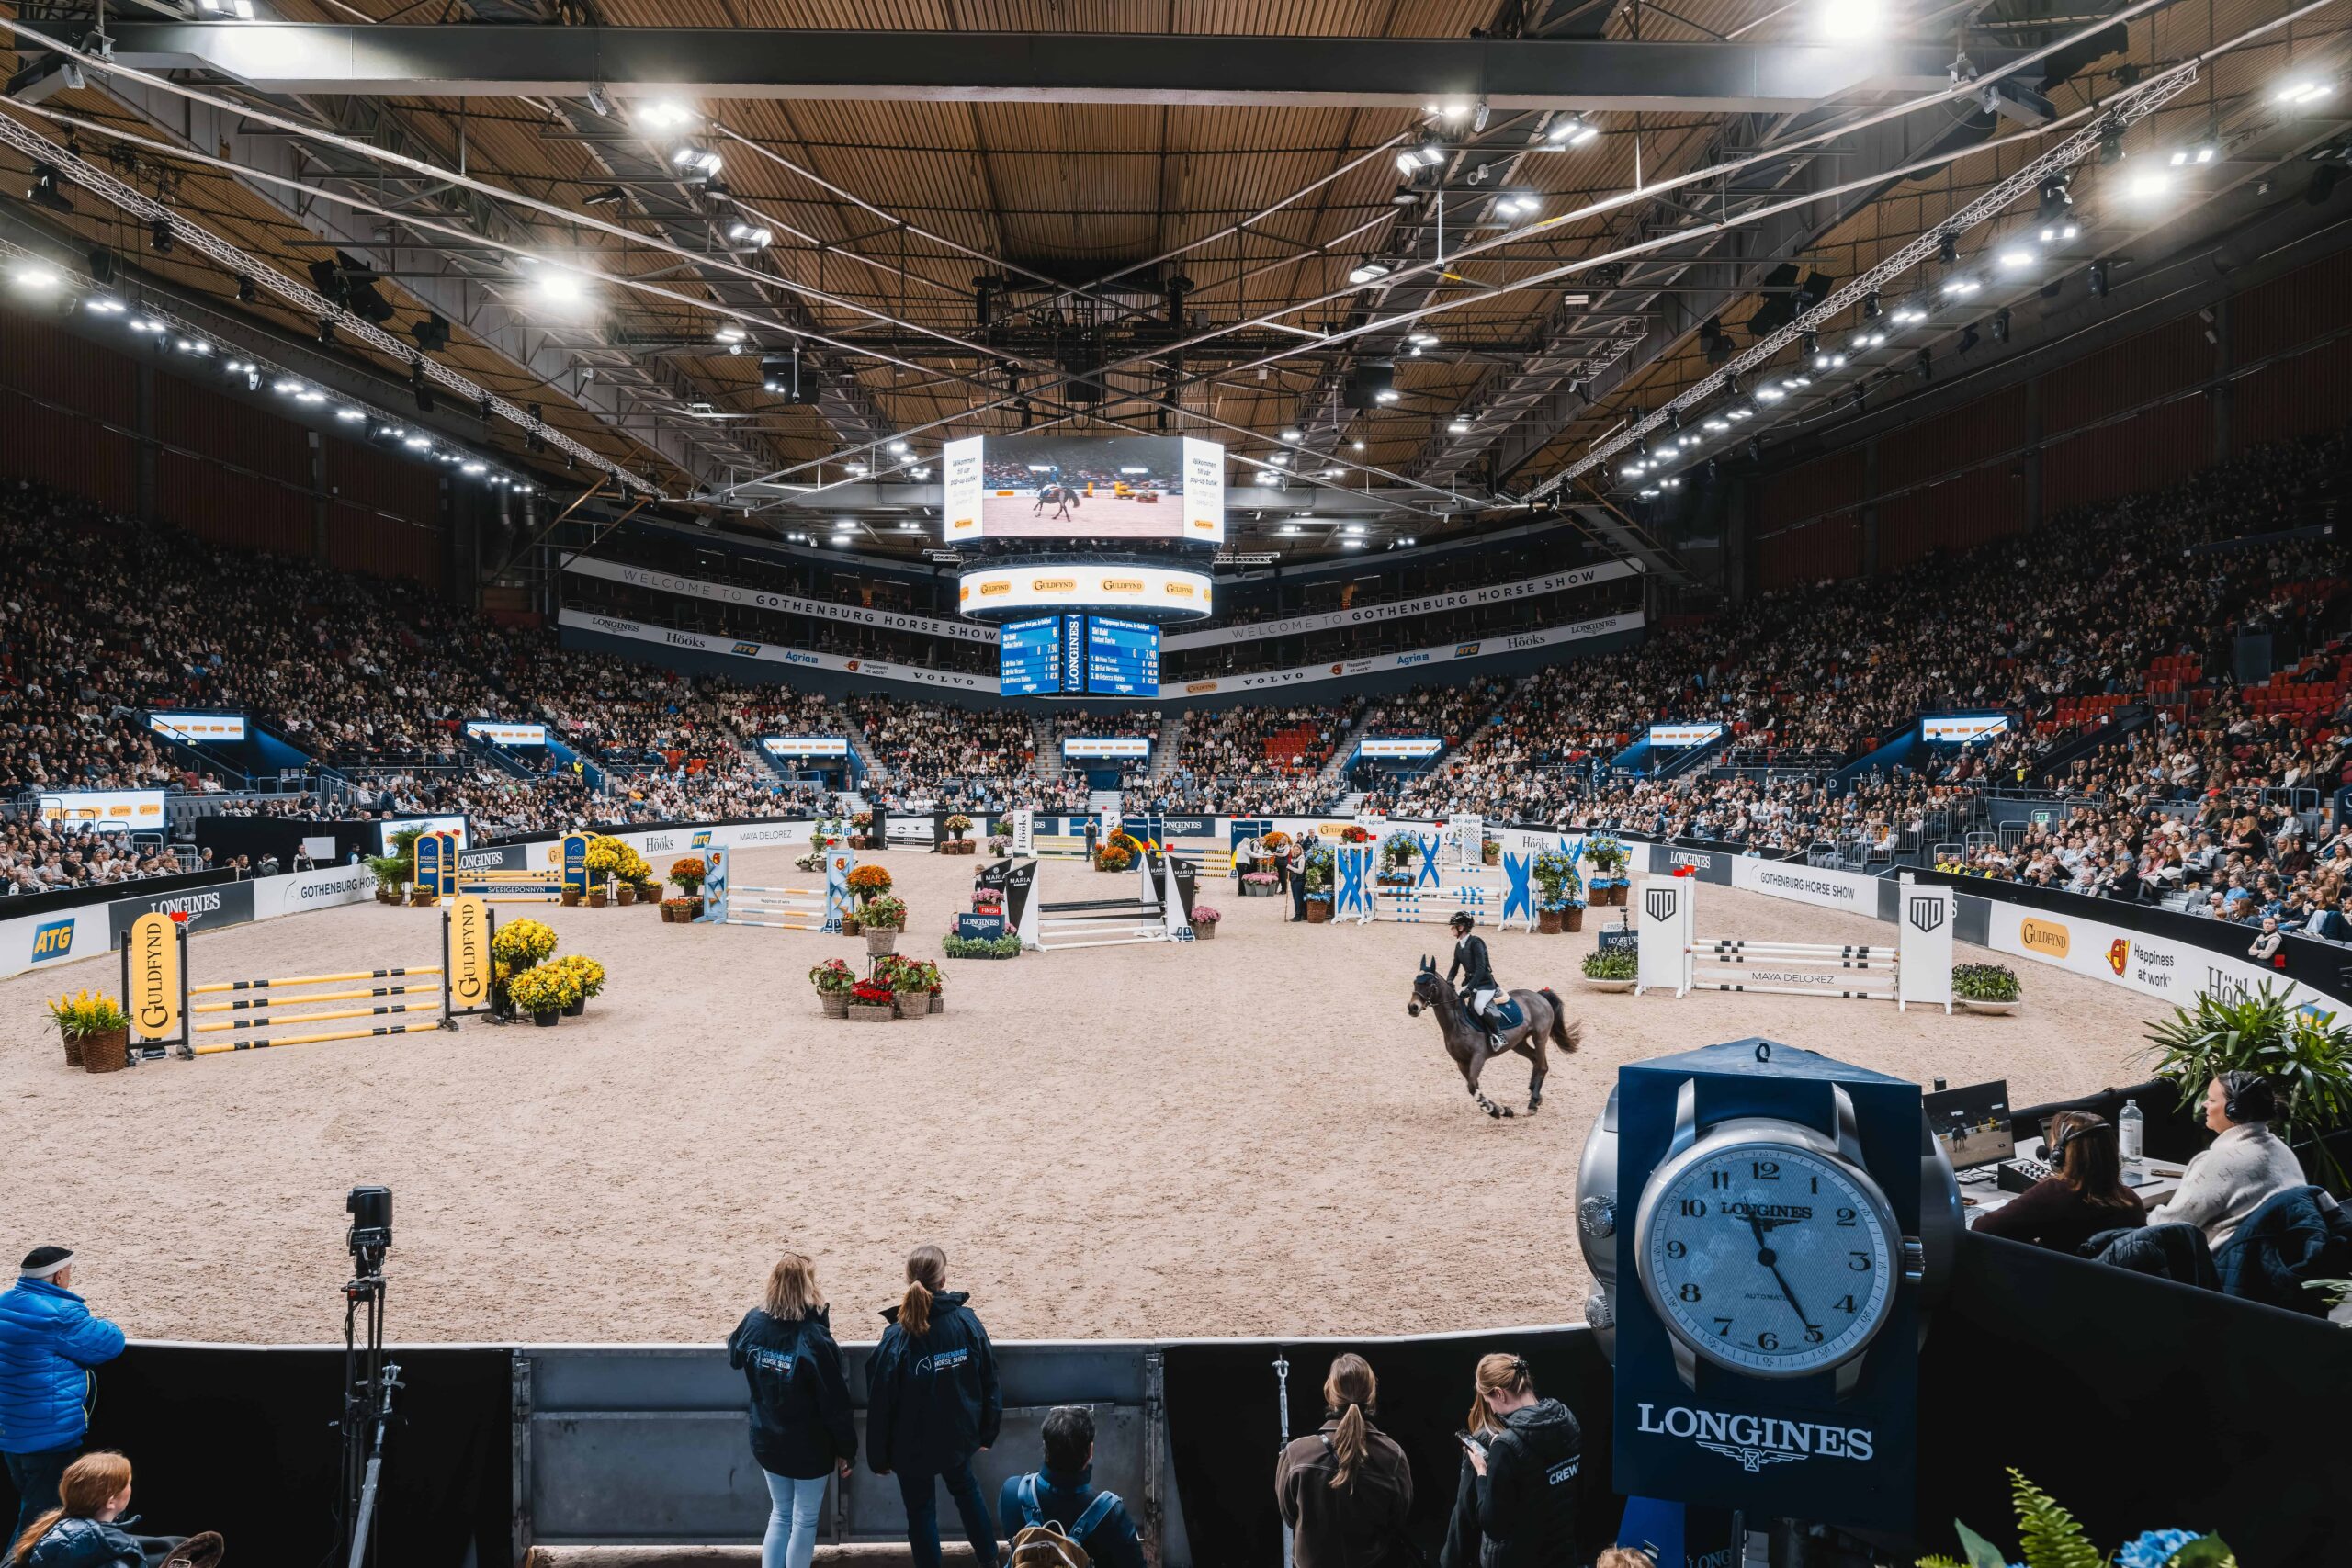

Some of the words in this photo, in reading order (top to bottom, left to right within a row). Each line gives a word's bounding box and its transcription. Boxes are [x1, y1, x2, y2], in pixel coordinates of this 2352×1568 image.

[1035, 581, 1073, 591] GULDFYND
[1103, 581, 1142, 590] GULDFYND
[623, 570, 711, 596] WELCOME
[720, 585, 742, 601] TO
[756, 594, 875, 623] GOTHENBURG
[884, 615, 940, 633] HORSE
[948, 625, 997, 642] SHOW
[1232, 617, 1314, 639] WELCOME
[1322, 615, 1343, 626] TO
[1352, 594, 1470, 622] GOTHENBURG
[1477, 584, 1535, 602] HORSE
[1544, 570, 1595, 590] SHOW
[592, 617, 639, 632] LONGINES
[1570, 619, 1617, 635] LONGINES
[665, 632, 706, 649] Hööks
[734, 643, 759, 656] ATG
[1507, 634, 1545, 649] Hööks
[785, 650, 812, 663] Agria
[1069, 621, 1079, 685] LONGINES
[1455, 644, 1479, 656] ATG
[1396, 654, 1423, 665] Agria
[913, 672, 974, 685] VOLVO
[1243, 672, 1304, 685] VOLVO
[1829, 779, 1838, 788] D
[692, 834, 711, 845] ATG
[741, 832, 758, 841] MAYA
[759, 830, 792, 840] DELOREZ
[1018, 814, 1027, 849] Hööks
[646, 836, 674, 852] Hööks
[1670, 851, 1711, 869] LONGINES
[301, 878, 358, 898] GOTHENBURG
[360, 876, 379, 890] HOR
[1760, 873, 1804, 891] GOTHENBURG
[1805, 880, 1830, 895] HORSE
[1832, 886, 1855, 900] SHOW
[34, 926, 72, 955] ATG
[2023, 923, 2066, 949] GULDFYND
[459, 904, 480, 998] GULDFYND
[2134, 944, 2175, 967] Happiness
[141, 922, 169, 1029] GULDFYND
[1751, 972, 1781, 981] MAYA
[1783, 974, 1834, 985] DELOREZ
[2137, 968, 2150, 981] at
[1752, 1161, 1780, 1180] 12
[1711, 1170, 1729, 1190] 11
[1810, 1176, 1818, 1194] 1
[1681, 1198, 1707, 1218] 10
[1720, 1201, 1812, 1219] LONGINES
[1836, 1207, 1857, 1227] 2
[1667, 1240, 1687, 1258] 9
[1849, 1251, 1871, 1271] 3
[1680, 1283, 1702, 1303] 8
[1832, 1295, 1857, 1314] 4
[1714, 1317, 1734, 1336] 7
[1804, 1325, 1824, 1343] 5
[1758, 1332, 1779, 1351] 6
[761, 1357, 777, 1367] HORSE
[933, 1348, 968, 1361] GOTHENBURG
[934, 1358, 952, 1367] HORSE
[953, 1354, 968, 1364] SHOW
[1637, 1403, 1873, 1461] LONGINES
[1549, 1462, 1578, 1484] CREW
